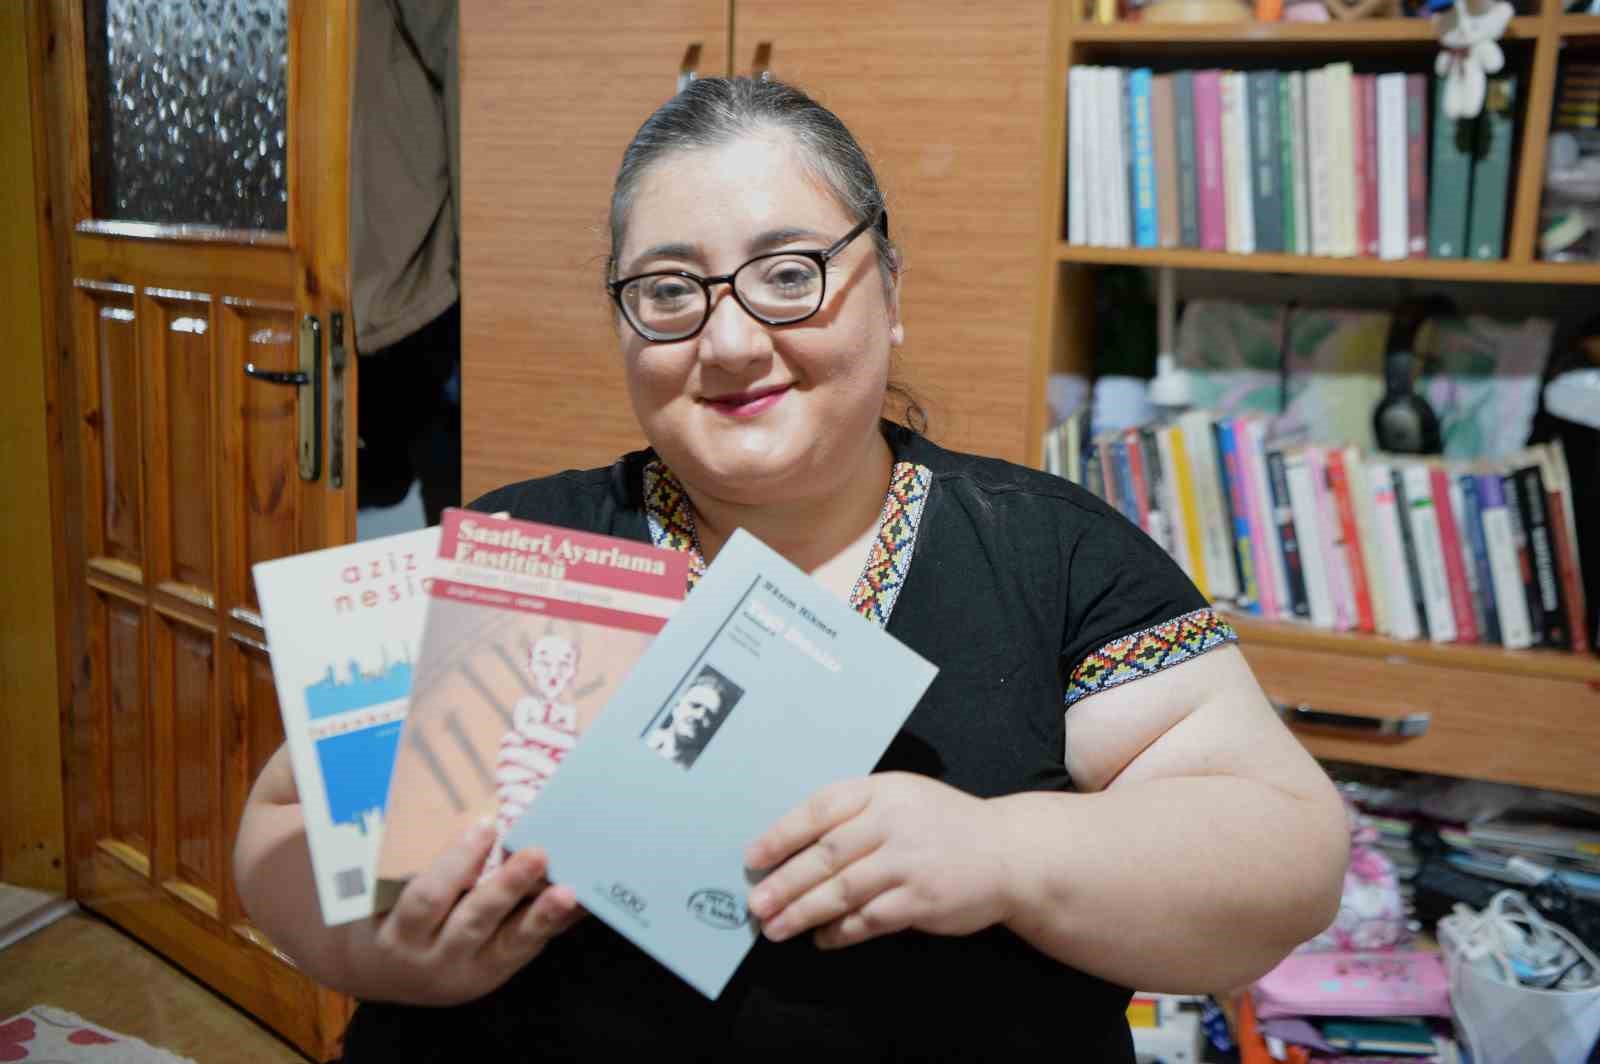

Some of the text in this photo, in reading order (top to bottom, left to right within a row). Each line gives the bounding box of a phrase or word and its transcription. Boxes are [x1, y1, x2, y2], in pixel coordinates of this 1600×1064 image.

[341, 551, 416, 584] aziz
[457, 519, 667, 577] Saatleri Ayarlama
